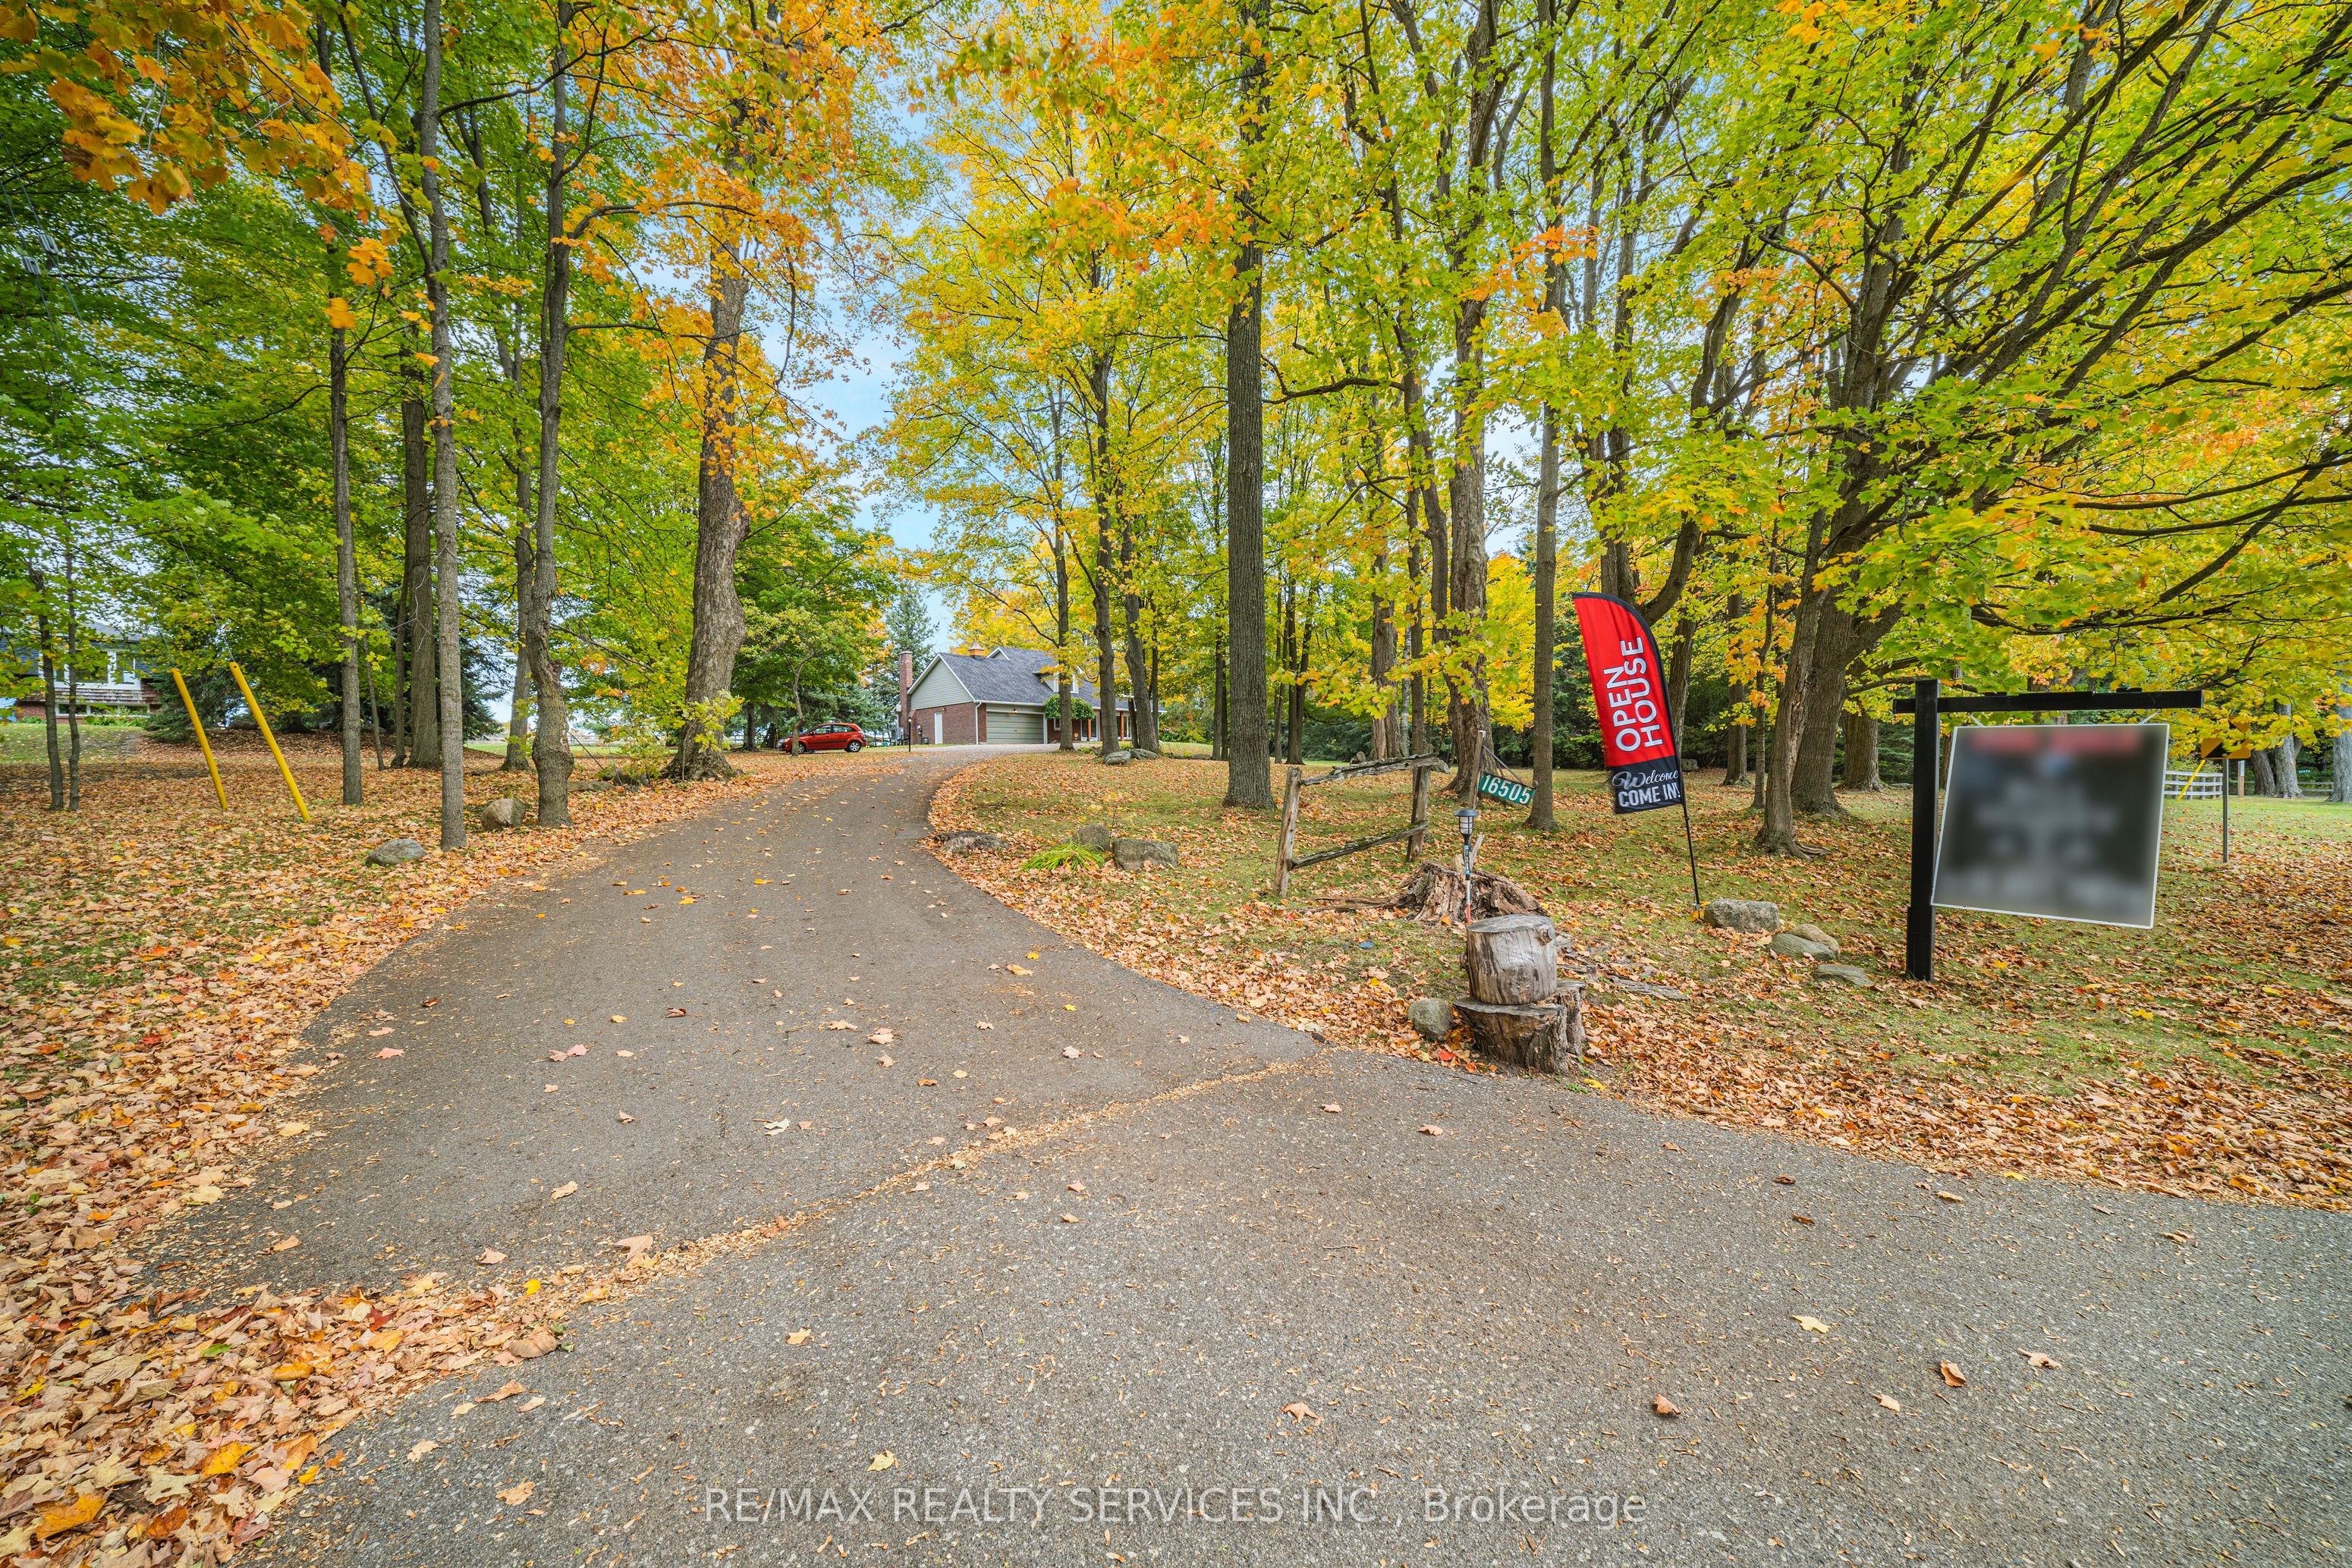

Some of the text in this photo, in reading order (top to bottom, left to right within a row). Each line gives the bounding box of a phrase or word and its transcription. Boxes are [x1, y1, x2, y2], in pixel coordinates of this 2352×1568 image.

[1620, 636, 1663, 748] HOUSE
[1603, 666, 1642, 753] OPEN
[1481, 774, 1531, 805] 16505
[1611, 769, 1679, 790] Welcome
[1618, 782, 1681, 808] COME IN!
